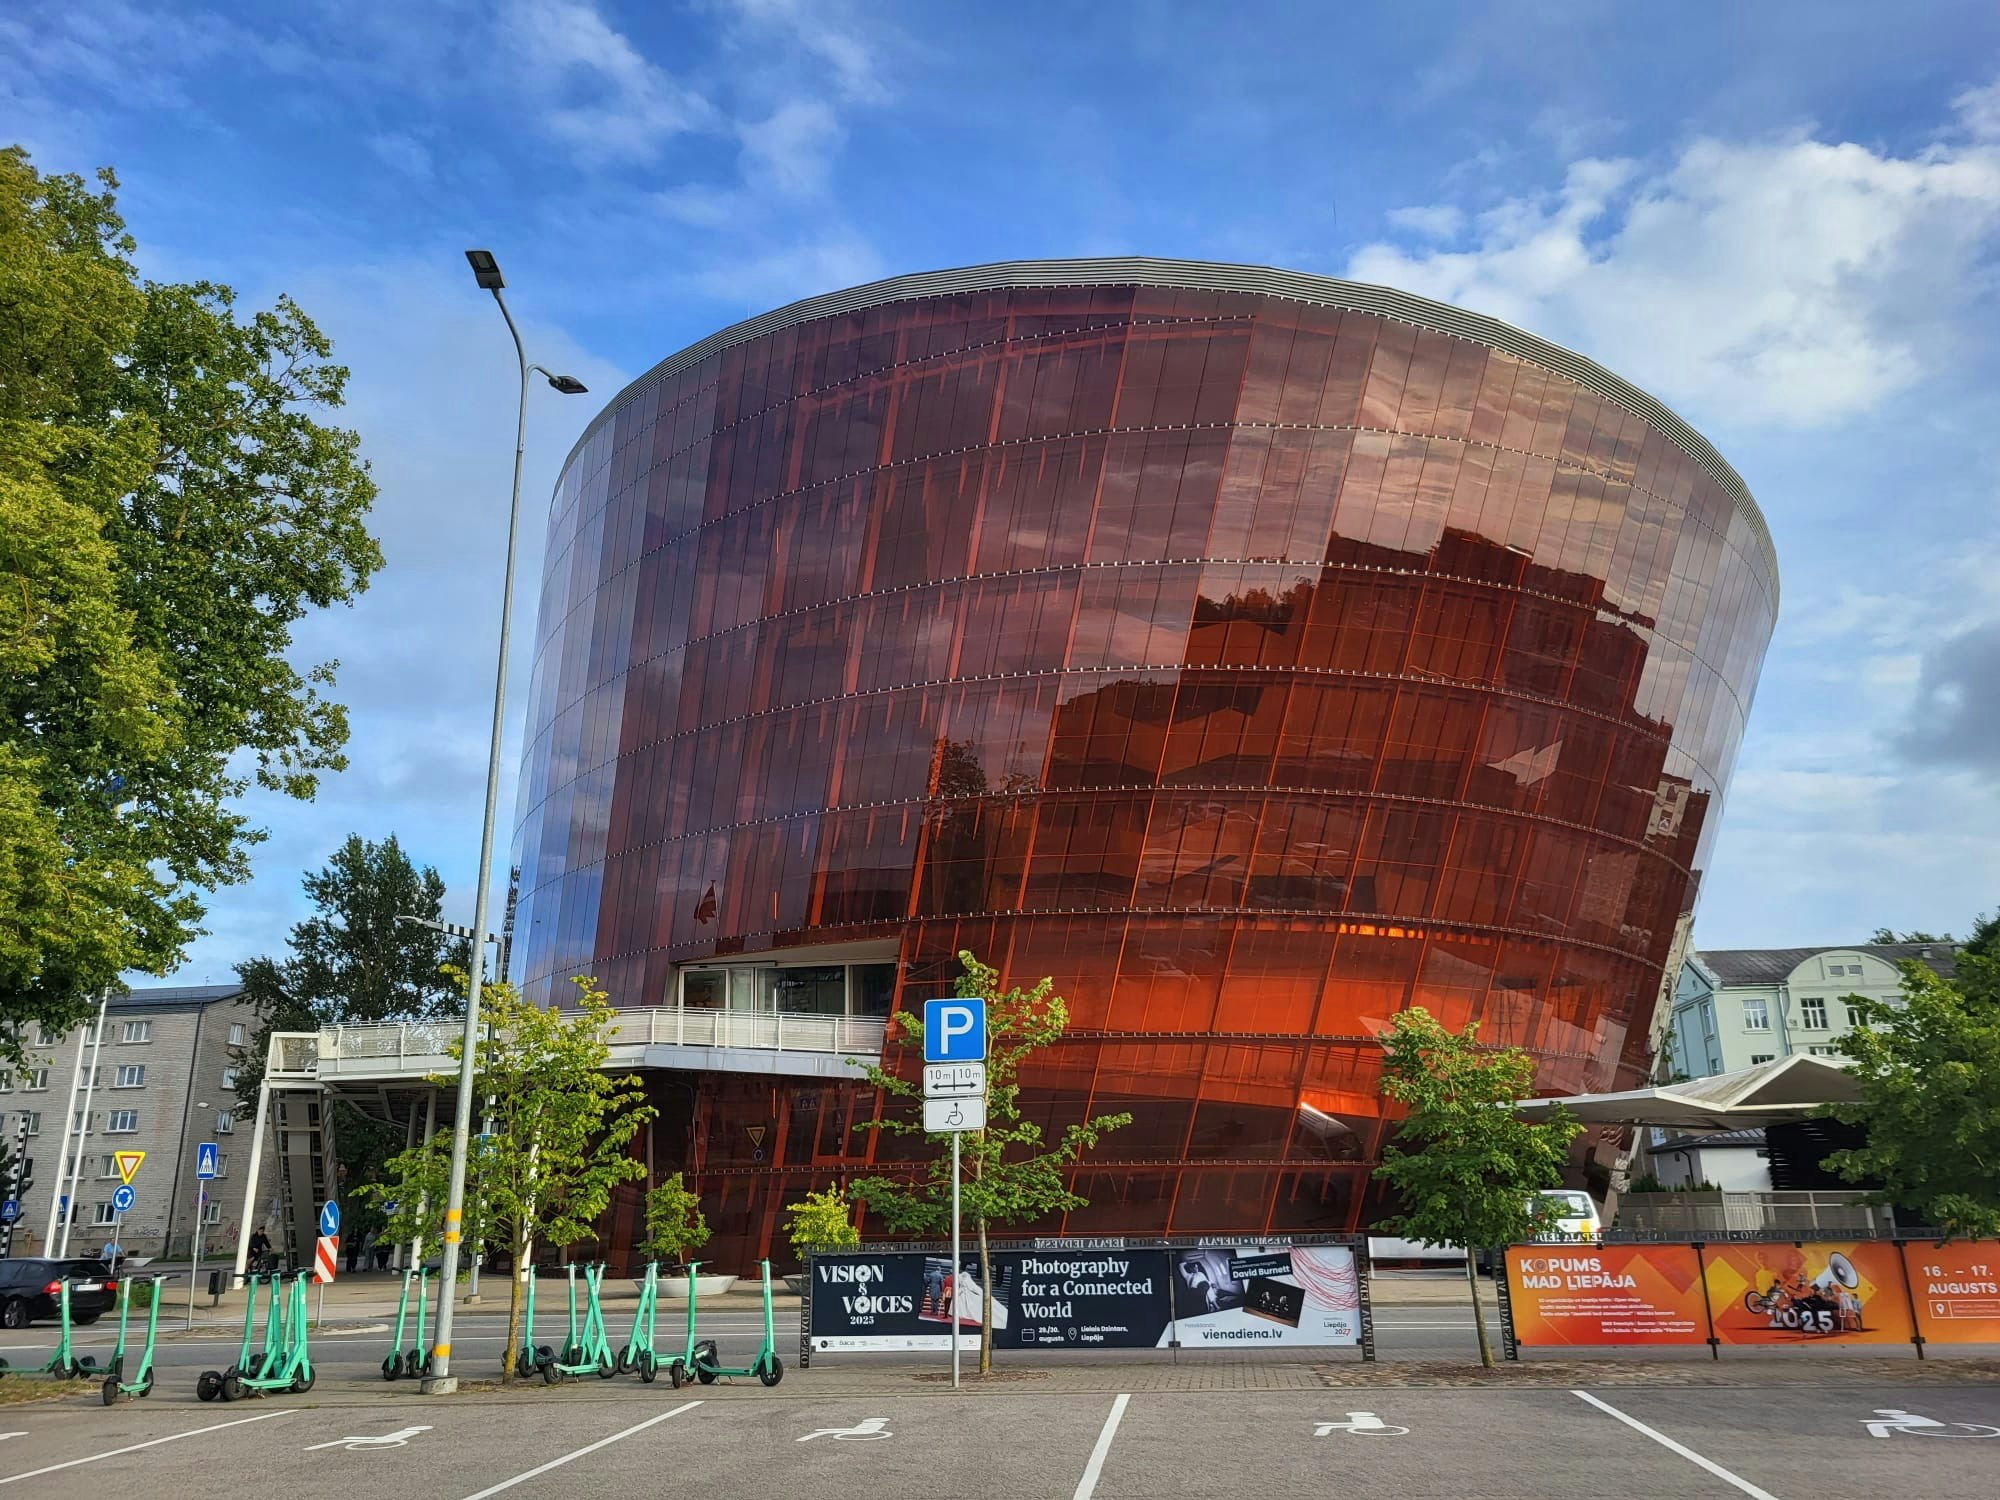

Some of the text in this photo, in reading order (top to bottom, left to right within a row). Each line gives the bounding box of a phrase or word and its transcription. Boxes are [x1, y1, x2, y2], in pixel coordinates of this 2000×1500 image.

[940, 1006, 974, 1055] P
[1021, 1257, 1129, 1278] Photography
[1233, 1269, 1258, 1279] David
[1258, 1265, 1291, 1276] Burnett
[1520, 1258, 1601, 1273] KOPUMS
[1923, 1265, 1948, 1277] 16.
[1971, 1265, 1993, 1276] 17.
[818, 1264, 884, 1283] VISION
[858, 1282, 868, 1296] &
[1021, 1278, 1153, 1296] for a Connected
[1523, 1275, 1562, 1289] MAD
[1928, 1282, 1998, 1294] AUGUSTS
[842, 1295, 913, 1314] VOICES
[1021, 1301, 1072, 1318] World
[1202, 1328, 1283, 1340] vienadiena.lv
